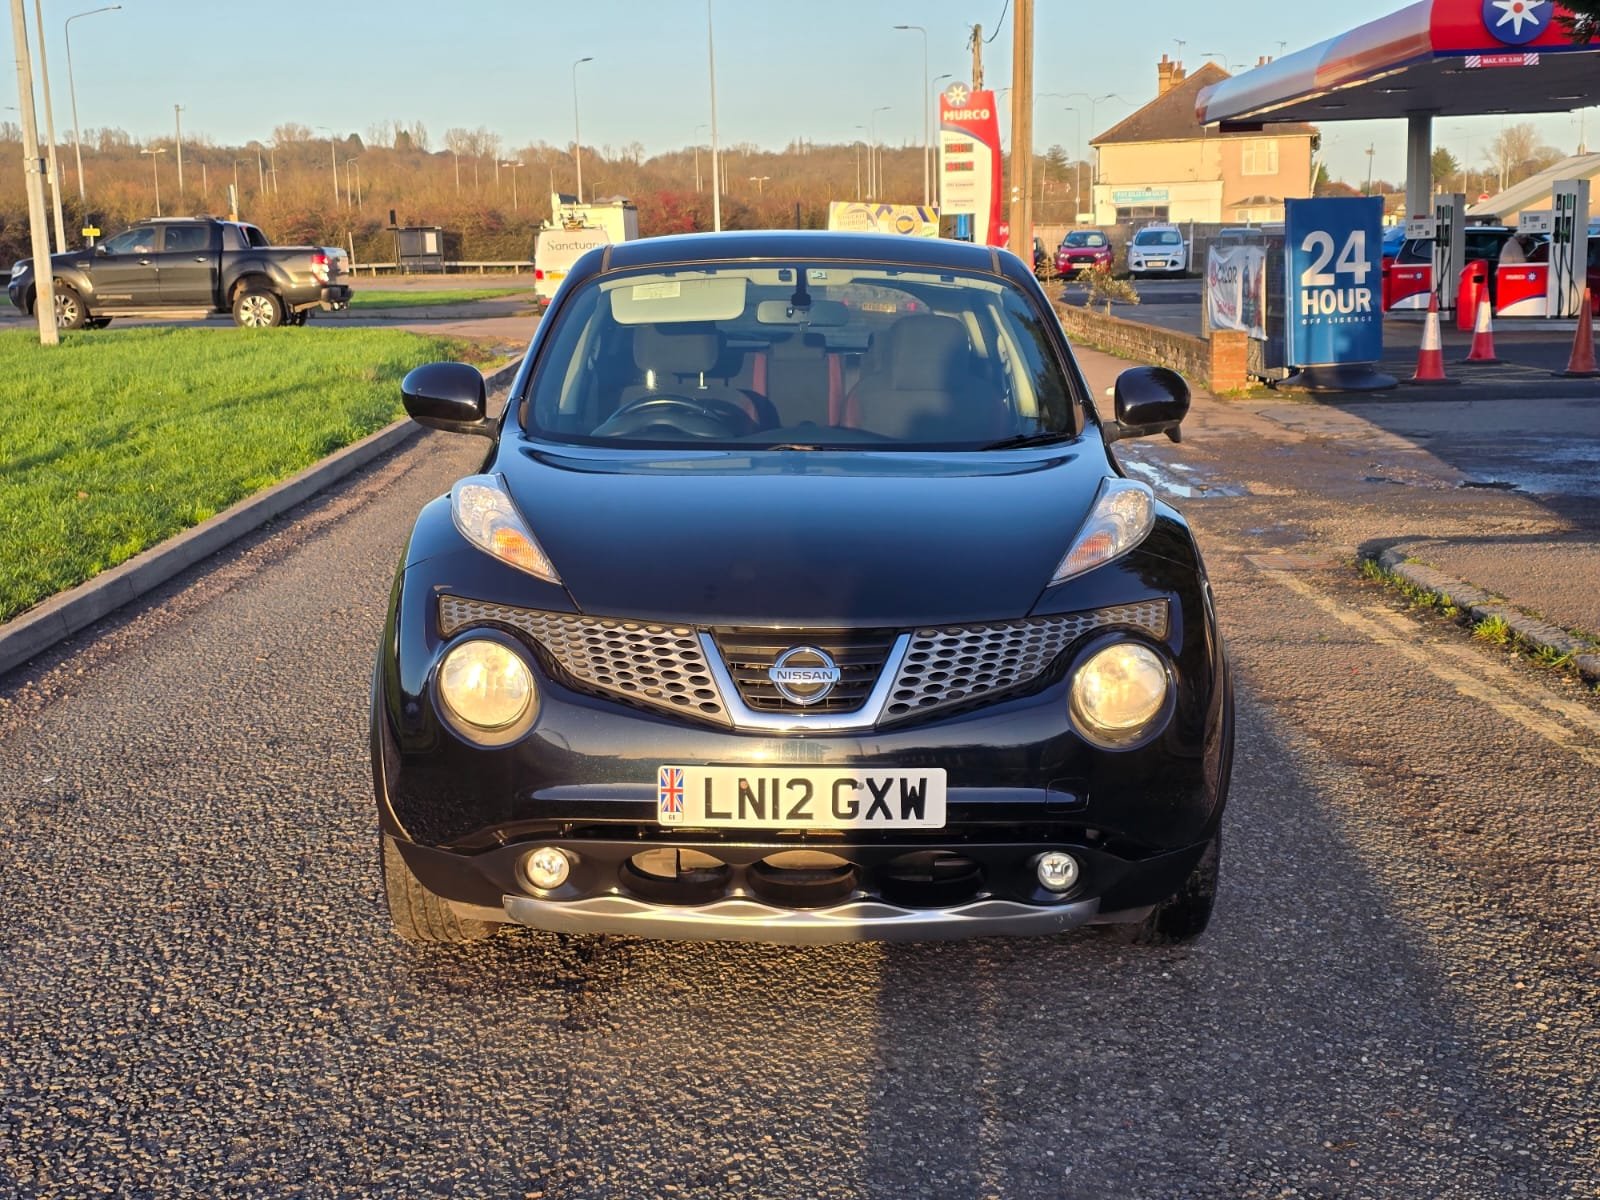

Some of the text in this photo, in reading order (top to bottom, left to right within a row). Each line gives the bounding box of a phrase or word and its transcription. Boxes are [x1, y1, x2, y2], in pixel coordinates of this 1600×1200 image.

[943, 109, 990, 121] MURCO
[1301, 230, 1371, 286] 24
[1301, 288, 1371, 315] HOUR
[1302, 317, 1321, 326] OFF
[777, 670, 833, 680] NISSAN
[704, 777, 927, 820] LN12 GXW
